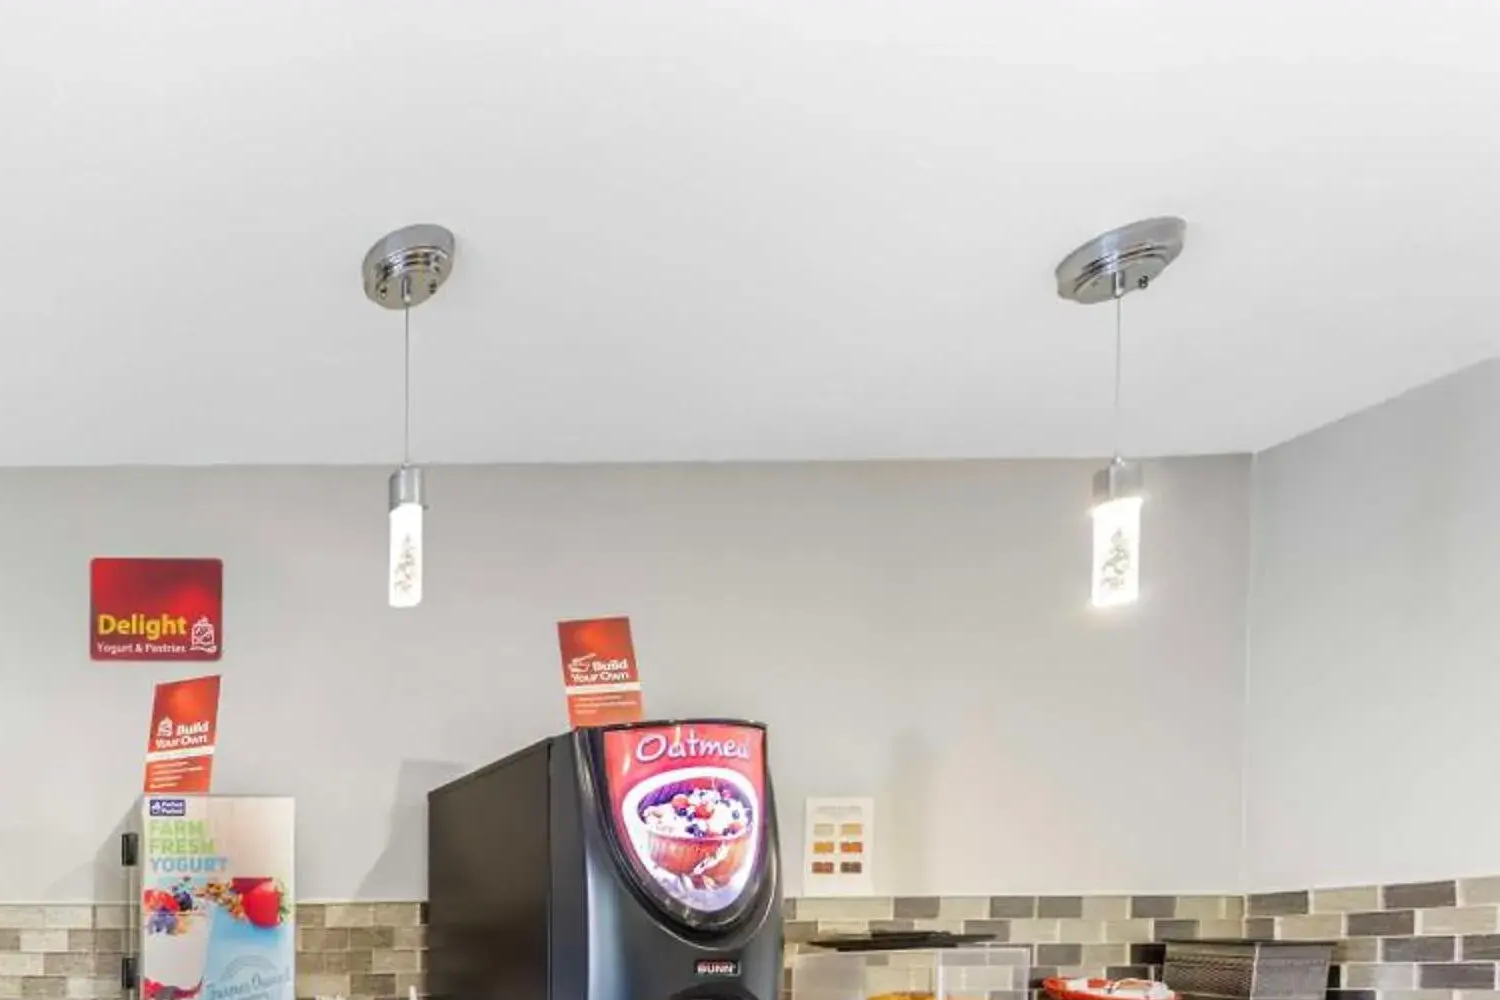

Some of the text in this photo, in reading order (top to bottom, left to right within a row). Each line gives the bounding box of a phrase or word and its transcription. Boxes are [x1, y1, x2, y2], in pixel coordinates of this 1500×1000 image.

[97, 613, 188, 640] Delight
[97, 642, 187, 655] Yogurt & Pastries
[592, 658, 629, 671] Build
[571, 671, 630, 683] Your Own
[176, 720, 210, 736] Build
[155, 734, 208, 750] Your Own
[635, 728, 752, 762] Oatmea
[150, 820, 205, 836] FARM
[150, 838, 215, 854] FRESH
[151, 857, 228, 873] YOGURT
[697, 962, 733, 974] BUNN
